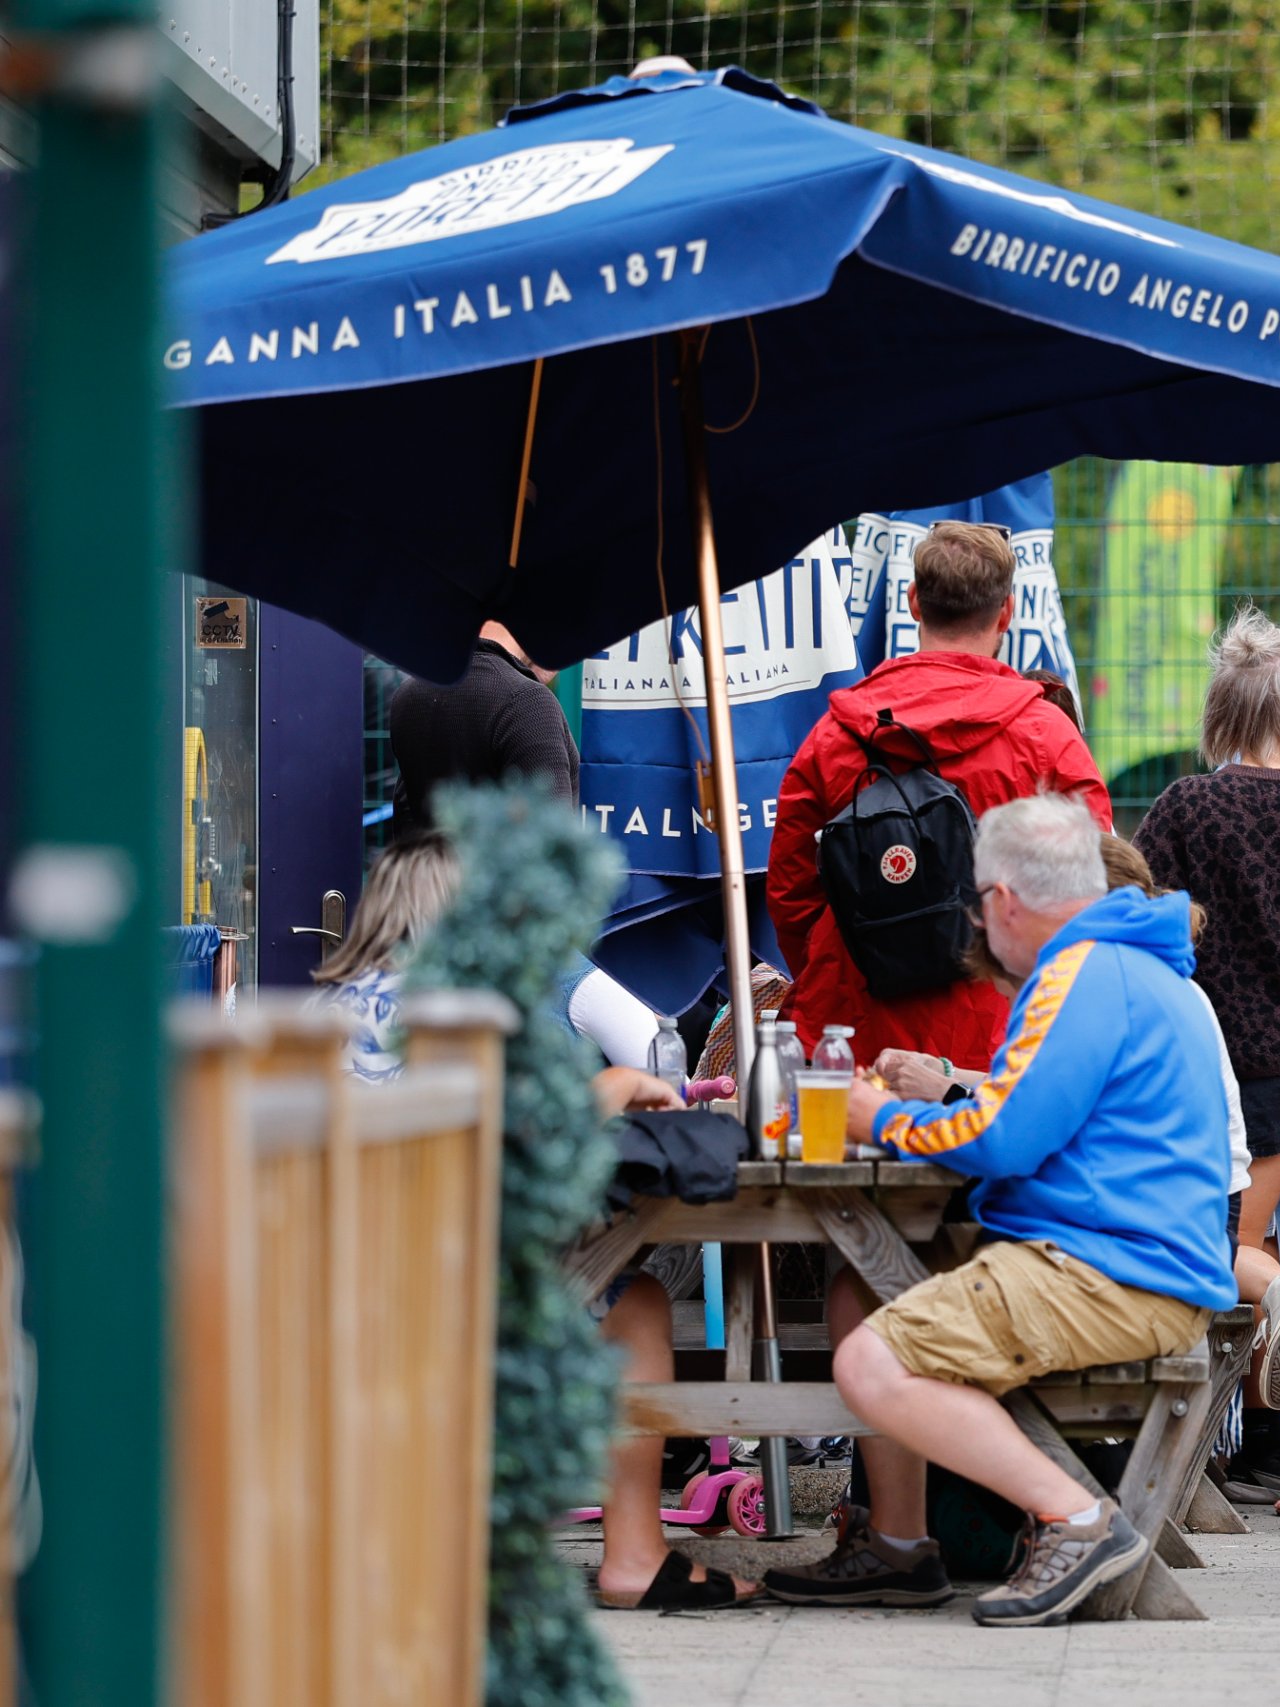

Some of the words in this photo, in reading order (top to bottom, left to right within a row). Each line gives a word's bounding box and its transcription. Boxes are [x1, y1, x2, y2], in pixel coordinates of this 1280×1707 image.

[315, 164, 622, 251] PORETTI
[394, 269, 572, 339] ITALIA
[600, 239, 708, 294] 1877
[951, 223, 1121, 296] BIRRIFICIO
[1129, 273, 1249, 334] ANGELO
[202, 624, 239, 636] CCTV
